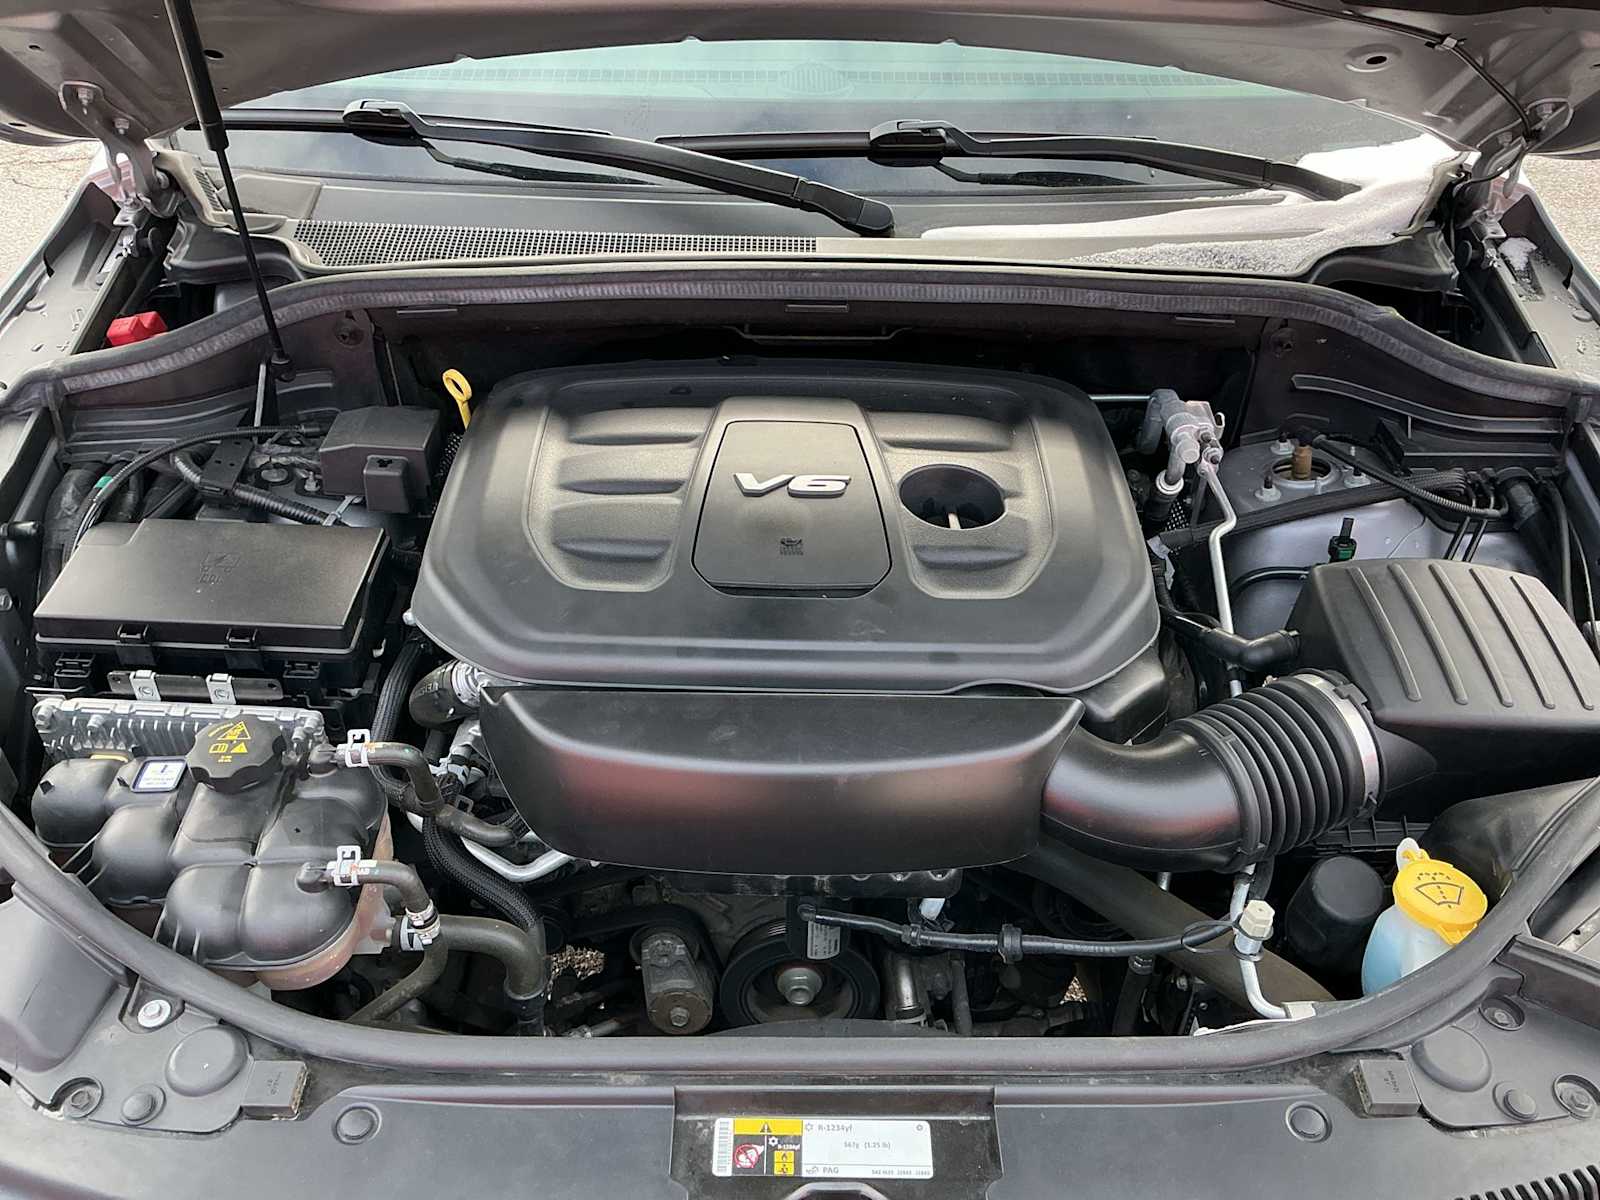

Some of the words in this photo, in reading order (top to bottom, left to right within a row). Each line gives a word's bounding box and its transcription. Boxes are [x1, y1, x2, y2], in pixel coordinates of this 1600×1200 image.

[733, 473, 851, 498] V6
[817, 1123, 853, 1133] R-1234yf
[822, 1166, 839, 1175] PAG
